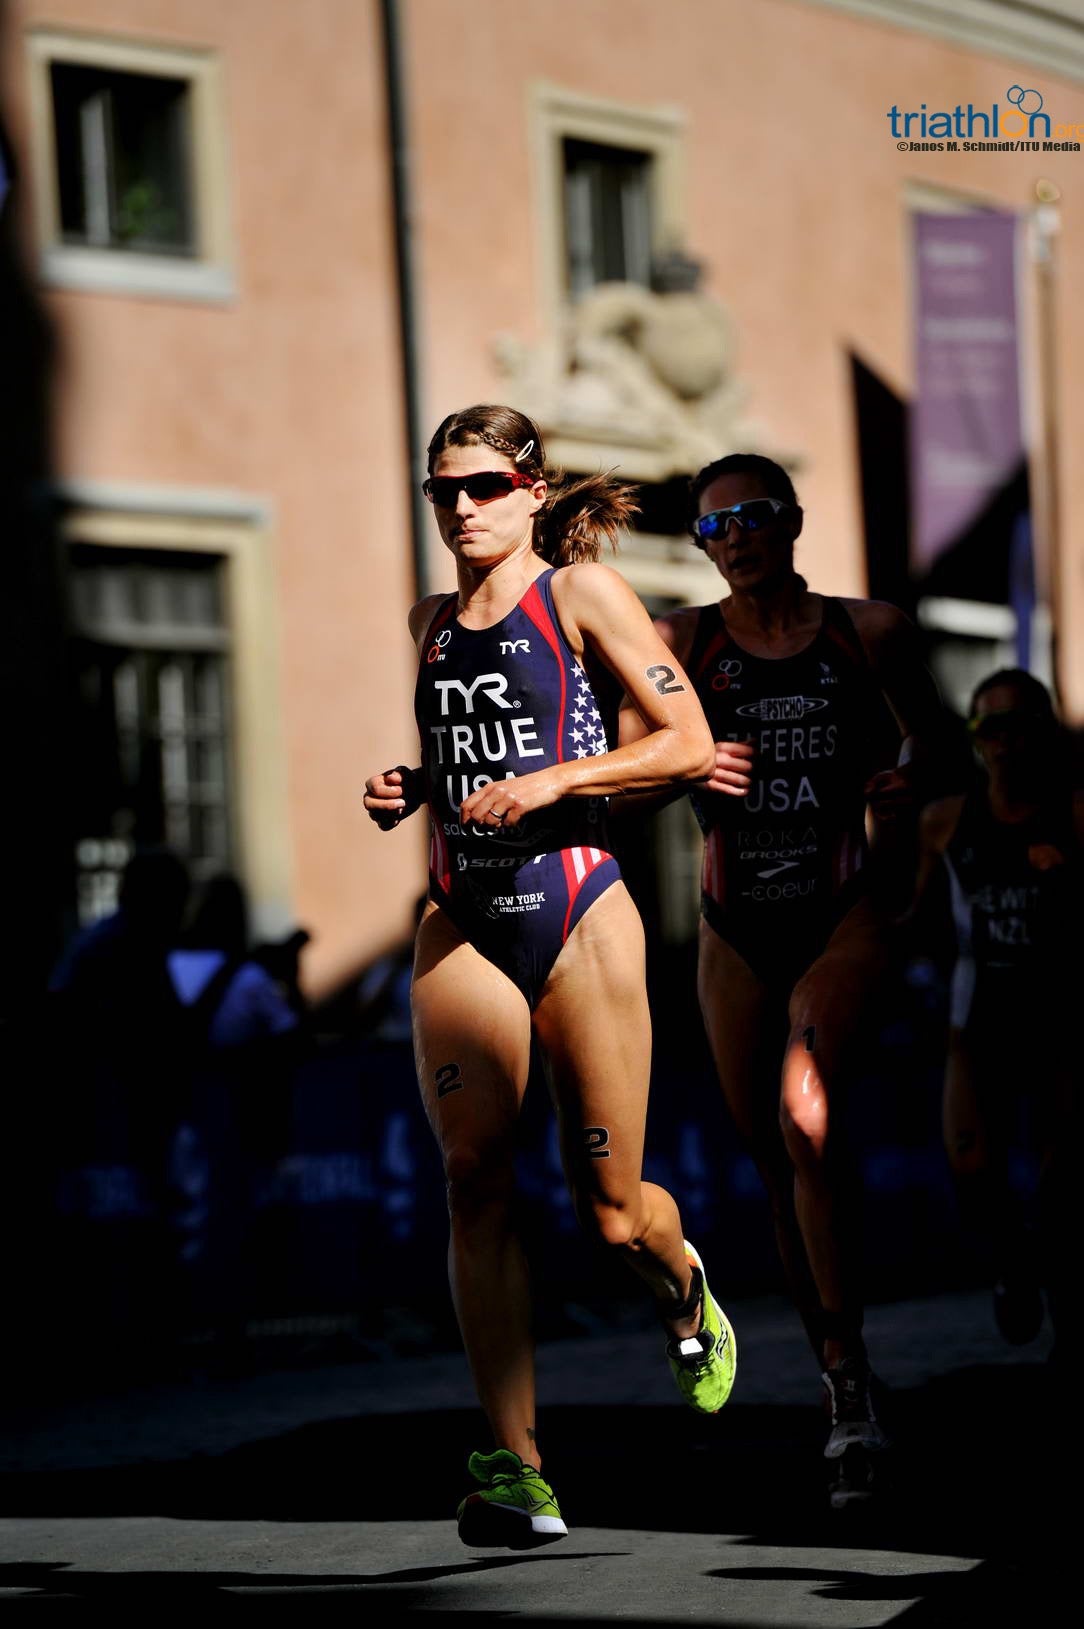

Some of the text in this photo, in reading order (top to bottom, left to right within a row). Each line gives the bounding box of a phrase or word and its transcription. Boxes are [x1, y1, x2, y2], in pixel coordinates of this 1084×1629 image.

[499, 639, 531, 655] TYR
[645, 664, 686, 695] 2
[430, 717, 545, 765] TRUE
[726, 724, 839, 763] FERES
[744, 775, 820, 813] USA
[738, 826, 817, 848] ROKA
[492, 891, 546, 906] NEW YORK
[525, 903, 541, 911] CLUB
[802, 1025, 815, 1051] 1
[434, 1063, 464, 1097] 2
[582, 1127, 611, 1158] 2
